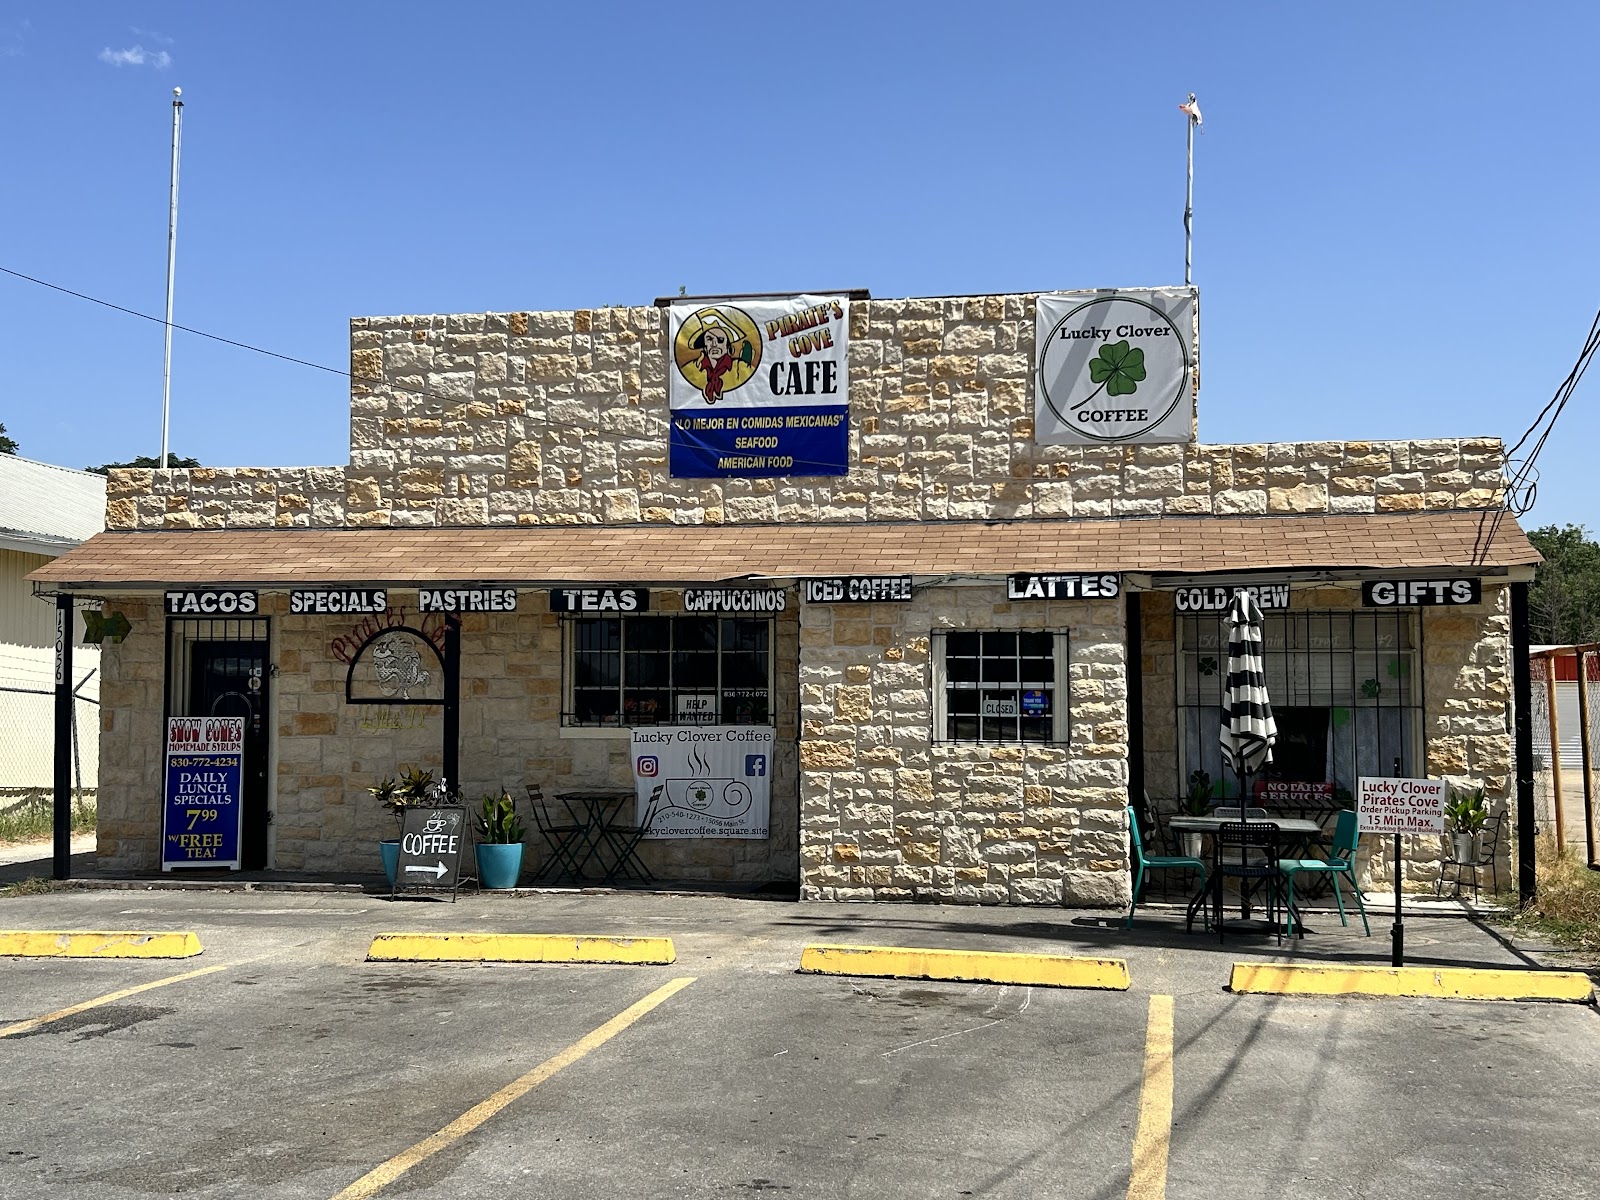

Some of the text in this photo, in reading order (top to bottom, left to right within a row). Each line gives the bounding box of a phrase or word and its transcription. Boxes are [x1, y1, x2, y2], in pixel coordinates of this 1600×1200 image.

[764, 299, 844, 341] PIRATE'S
[1060, 325, 1171, 341] Lucky Clover
[788, 327, 834, 358] COVE
[769, 360, 837, 395] CAFE
[693, 417, 724, 430] MEJOR
[726, 417, 739, 430] EN
[741, 416, 783, 429] COMIDAS
[1077, 409, 1148, 423] COFFEE
[735, 436, 778, 449] SEAFOOD
[717, 456, 793, 469] AMERICAN FOOD
[807, 578, 911, 601] ICED COFFEE
[1008, 575, 1118, 598] LATTES
[1371, 580, 1472, 605] GIFTS
[166, 592, 256, 612] TACOS
[291, 591, 386, 612] SPECIALS
[419, 590, 516, 611] PASTRIES
[562, 590, 637, 610] TEAS
[684, 589, 785, 611] CAPPUCCINOS
[1176, 588, 1227, 610] COLD
[55, 609, 63, 681] 15056
[686, 699, 708, 709] HELP
[986, 703, 1014, 714] CLOSED
[679, 711, 713, 721] WANTED
[170, 718, 243, 742] SNOW CONES
[633, 730, 771, 745] Lucky Clover Coffee
[168, 742, 241, 752] HOMEMADE SYRUPS
[170, 757, 238, 767] 830-772-4234
[180, 772, 228, 783] DAILY
[179, 784, 227, 794] LUNCH
[1260, 791, 1332, 800] SERVICES
[1362, 780, 1441, 796] Lucky Clover
[174, 794, 232, 805] SPECIALS
[1363, 793, 1439, 808] Pirates Cove
[1360, 805, 1442, 818] Order Pickup Parking
[657, 811, 701, 824] 210-540-1273
[705, 816, 723, 827] 15056
[723, 819, 738, 828] Main
[1368, 815, 1434, 827] 15 Min Max.
[645, 825, 768, 837] kyclovercoffee.square.site
[1375, 825, 1396, 833] Parking
[1418, 827, 1442, 835] Building
[179, 834, 223, 847] FREE
[402, 832, 459, 856] COFFEE
[185, 848, 217, 858] TEA!
